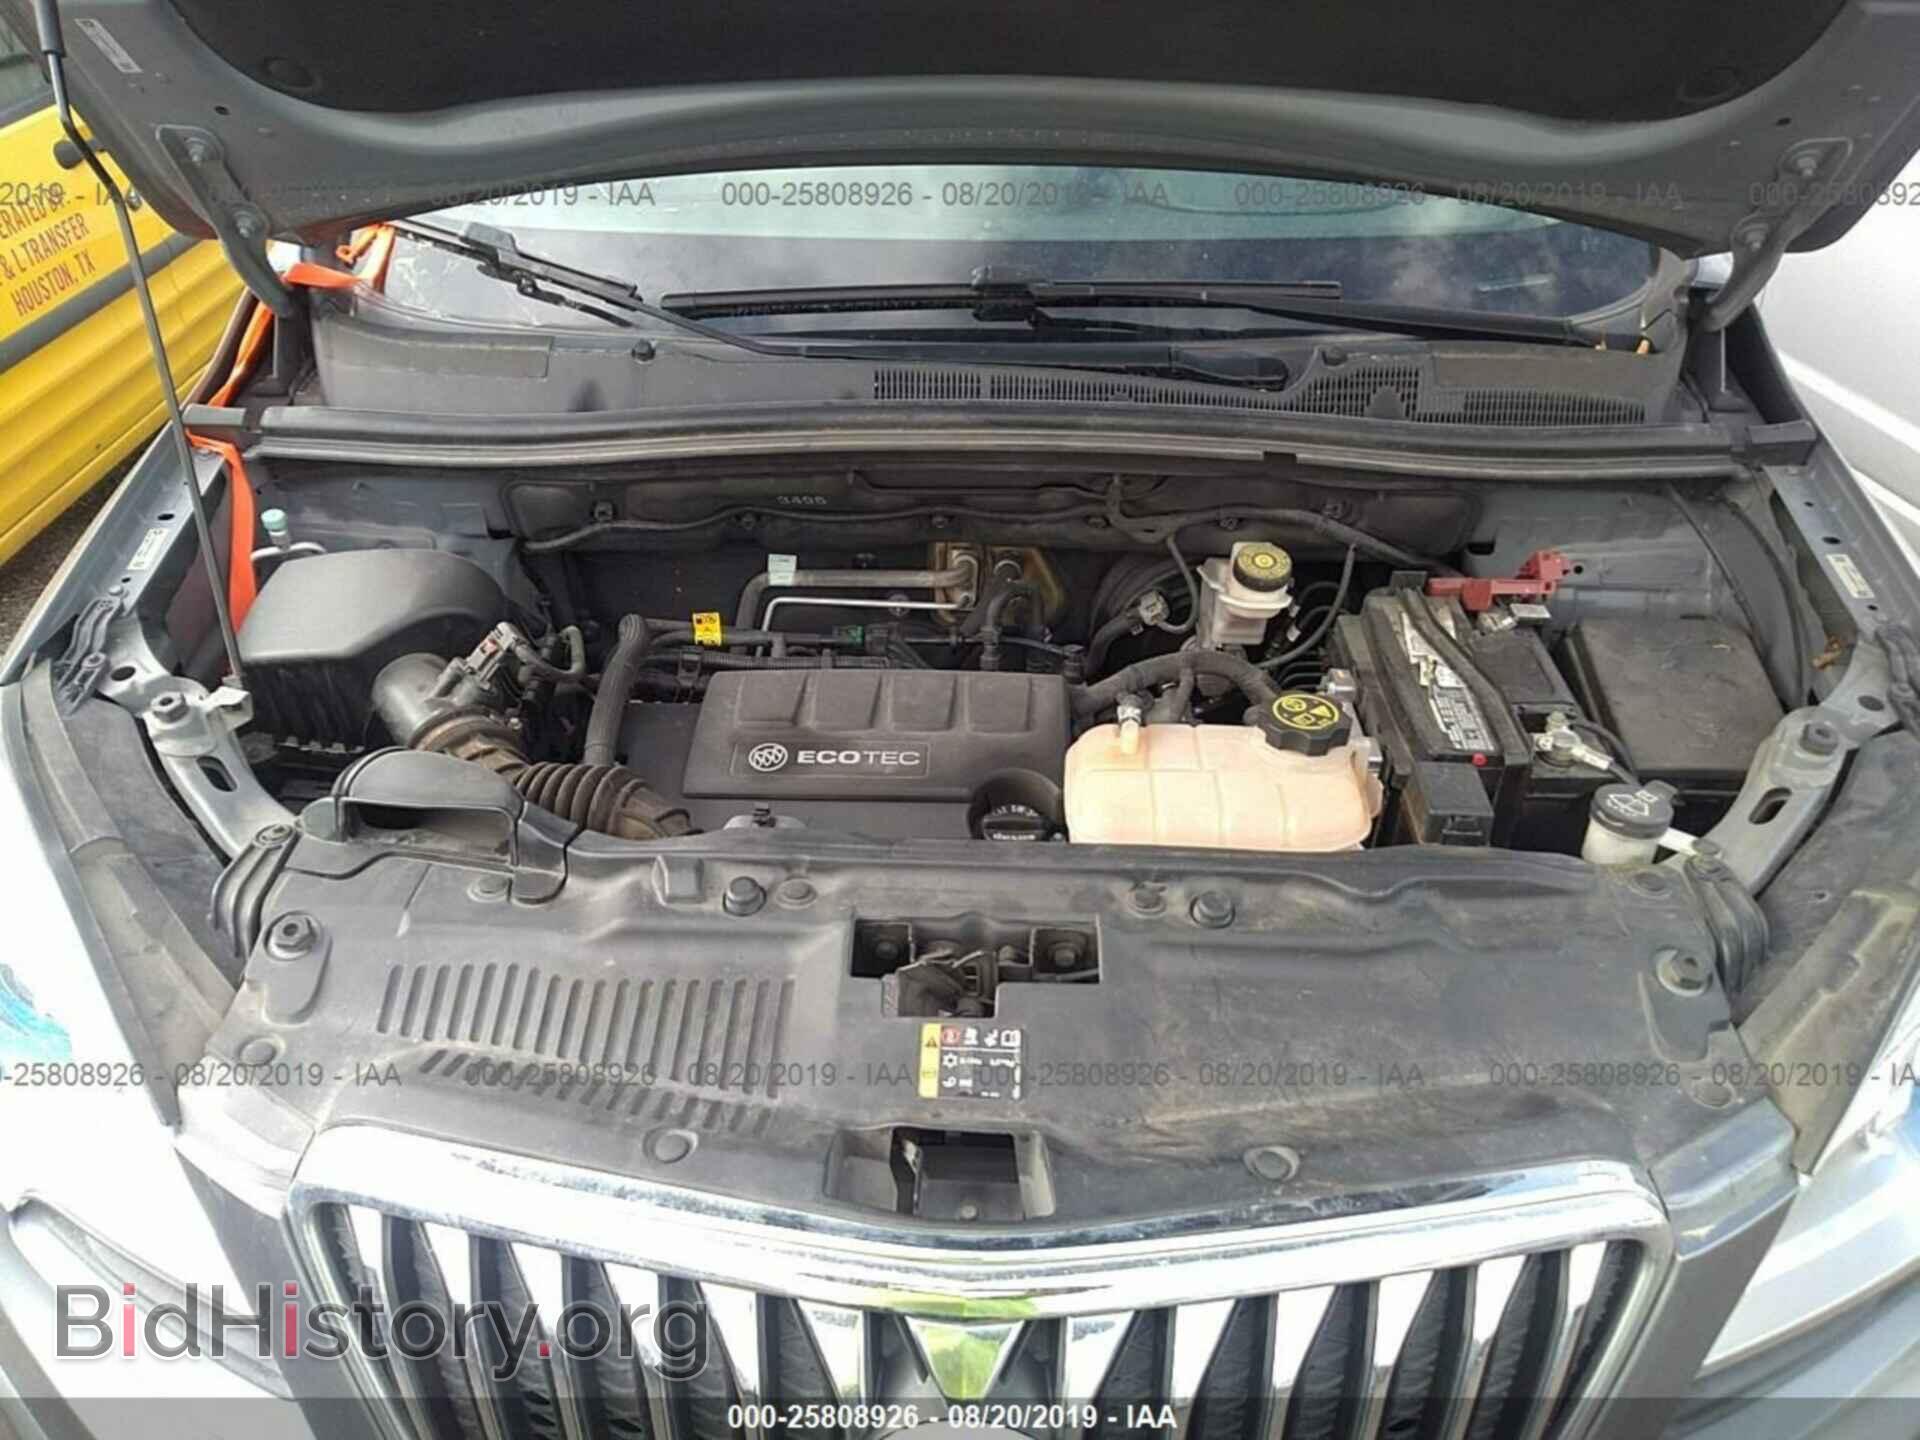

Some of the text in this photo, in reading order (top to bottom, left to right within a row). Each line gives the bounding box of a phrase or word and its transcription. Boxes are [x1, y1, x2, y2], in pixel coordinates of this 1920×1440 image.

[20, 212, 90, 267] TRANSFER
[73, 248, 96, 278] TX
[797, 750, 921, 766] ECOTEC
